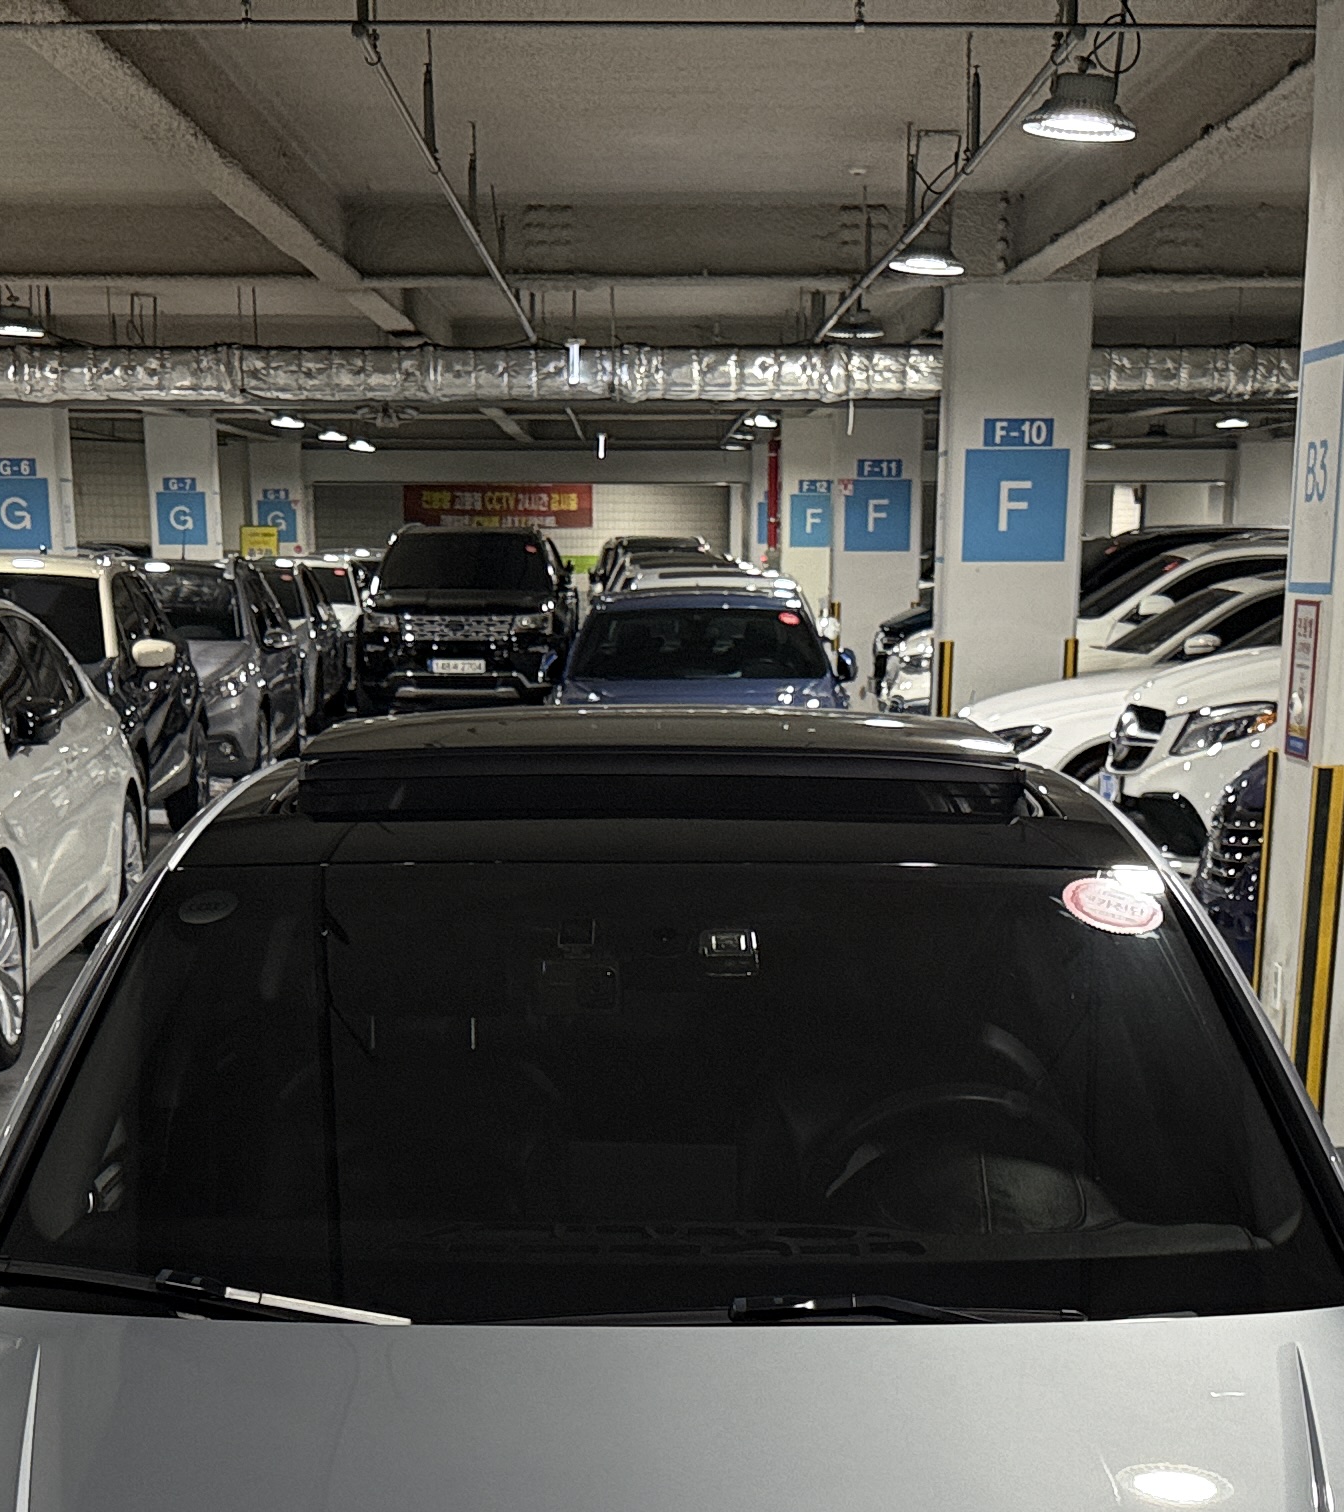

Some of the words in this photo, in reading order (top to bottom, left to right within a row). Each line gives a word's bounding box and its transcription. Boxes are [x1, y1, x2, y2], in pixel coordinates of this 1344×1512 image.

[994, 421, 1047, 445] F-10
[0, 460, 31, 475] G-6
[863, 461, 897, 476] F-11
[1305, 439, 1328, 502] B3
[168, 479, 192, 491] G-7
[802, 481, 828, 493] F-12
[0, 496, 31, 530] G
[169, 505, 194, 530] G
[868, 499, 890, 532] F
[998, 480, 1033, 532] F
[267, 511, 287, 532] G
[805, 508, 823, 534] F
